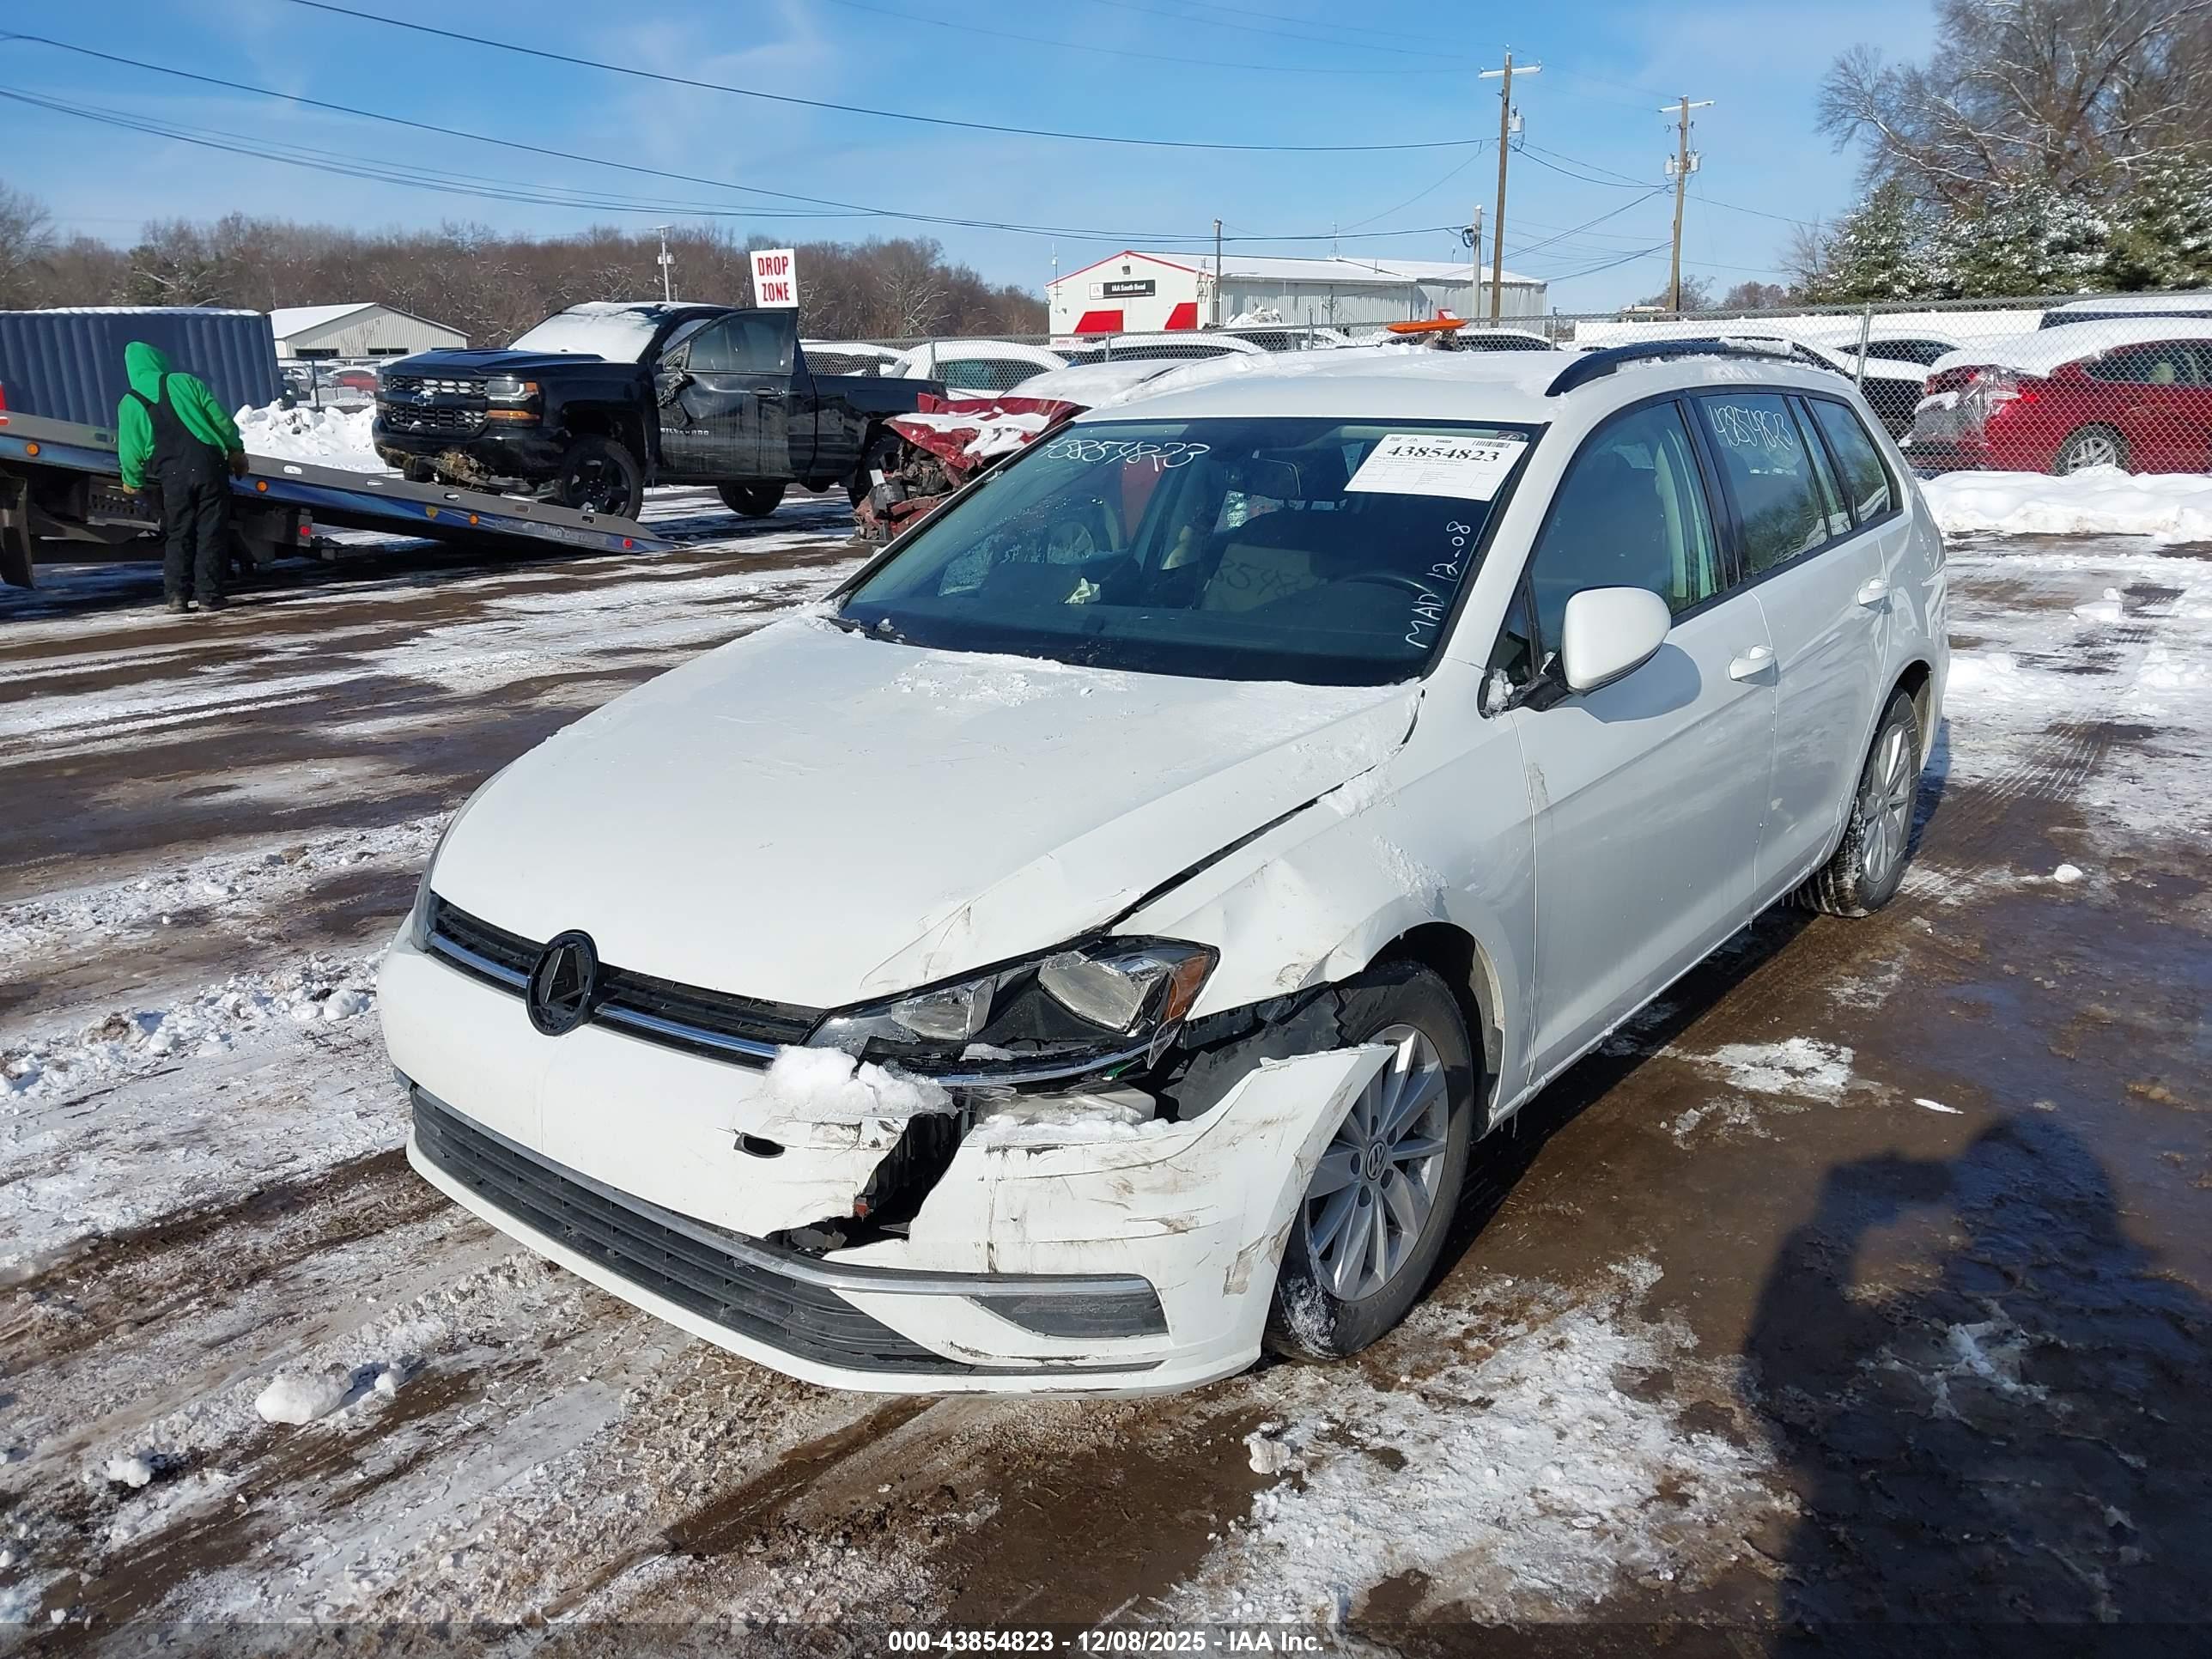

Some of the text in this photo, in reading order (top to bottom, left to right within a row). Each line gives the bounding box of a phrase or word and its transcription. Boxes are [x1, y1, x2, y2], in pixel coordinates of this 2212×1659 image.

[757, 256, 789, 276] DROP
[761, 282, 791, 302] ZONE
[1134, 282, 1146, 290] Bend
[1387, 445, 1501, 463] 43854823
